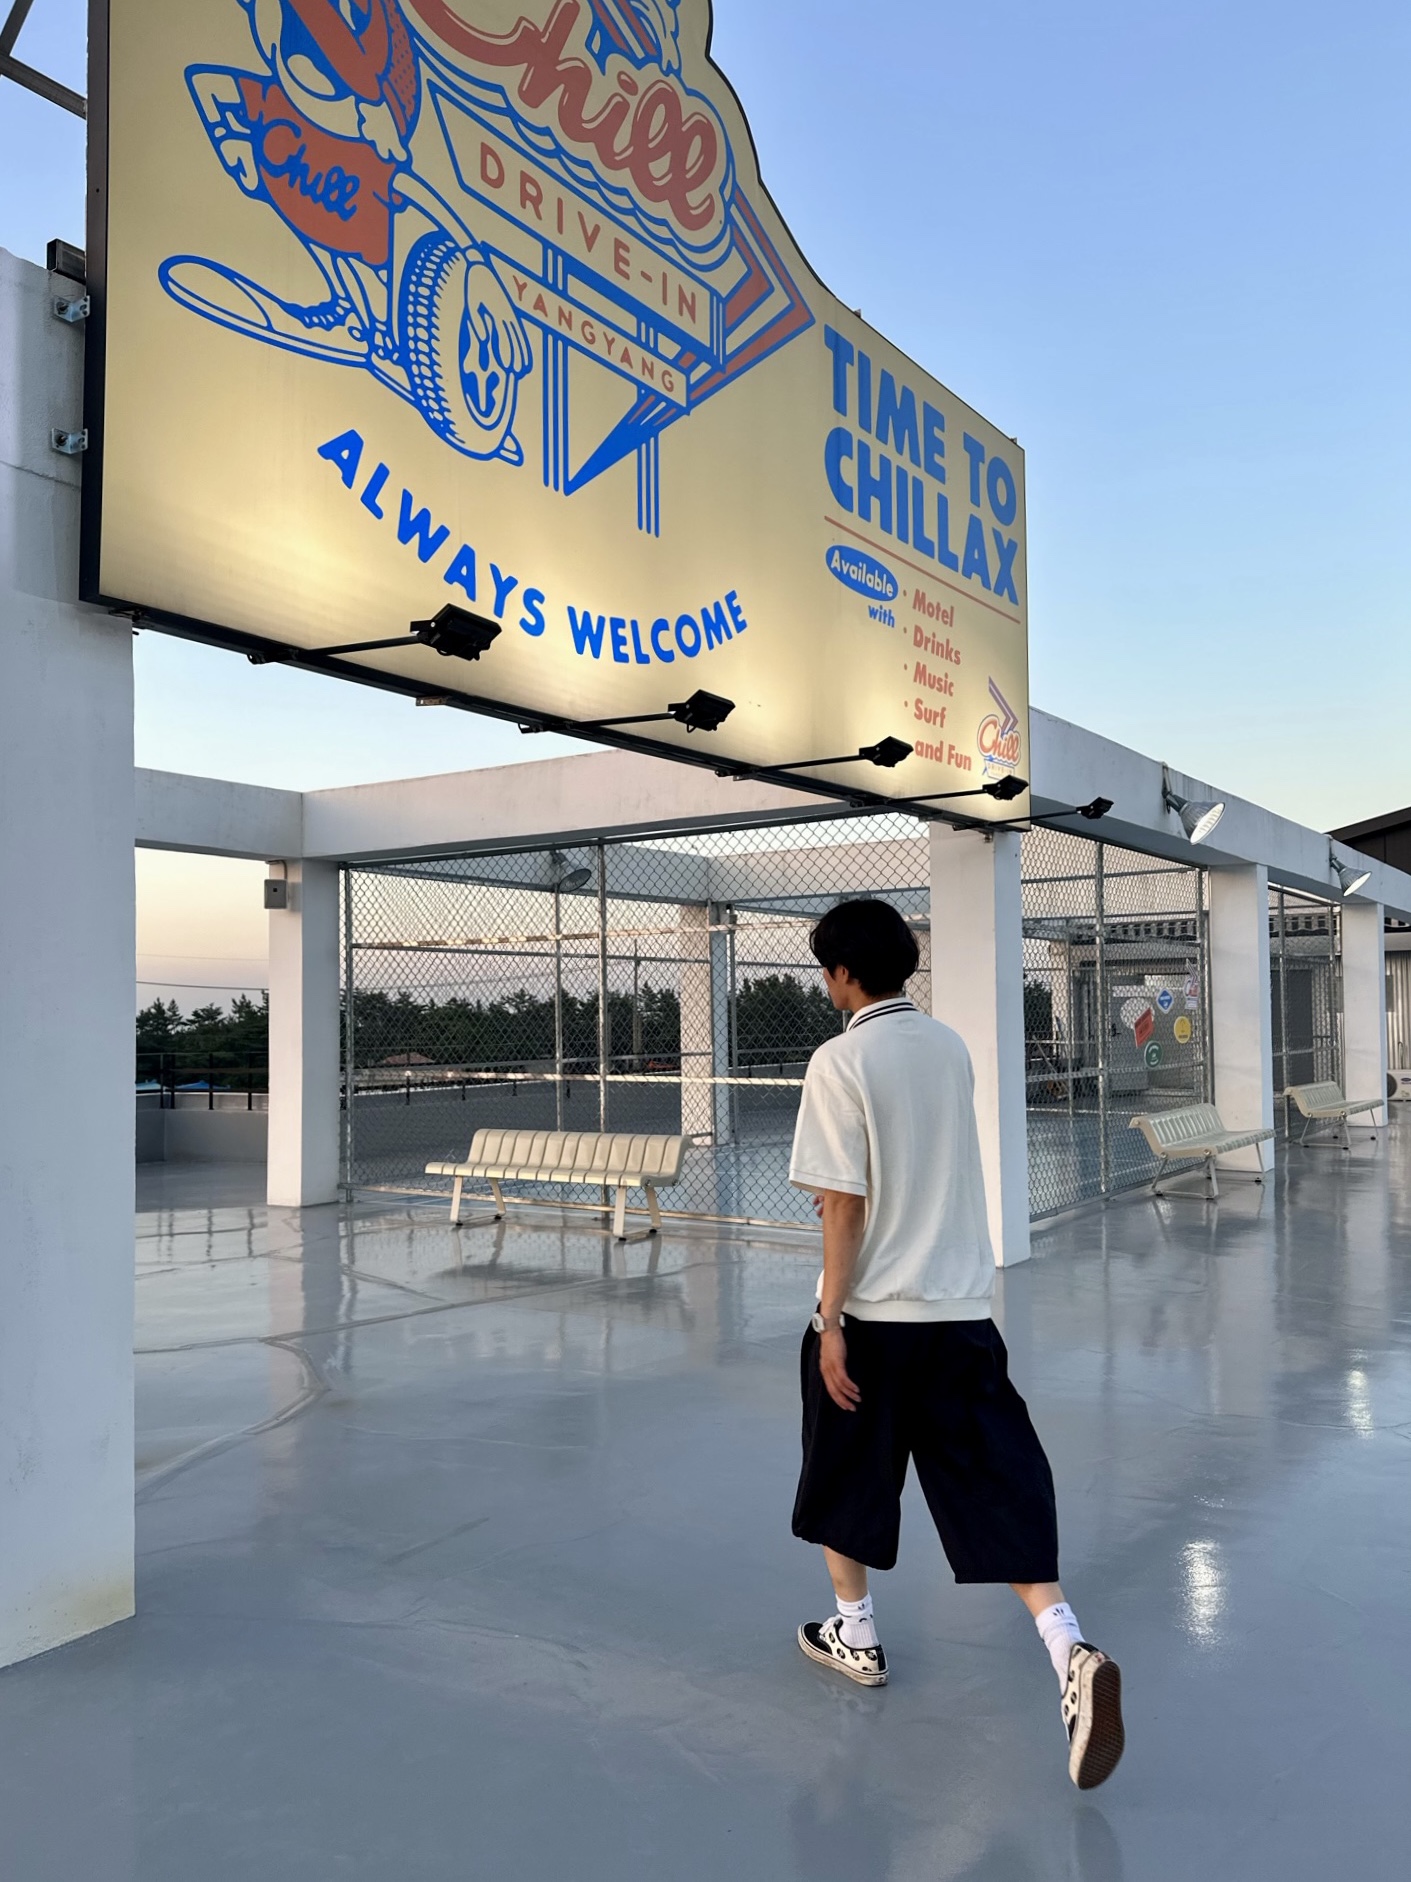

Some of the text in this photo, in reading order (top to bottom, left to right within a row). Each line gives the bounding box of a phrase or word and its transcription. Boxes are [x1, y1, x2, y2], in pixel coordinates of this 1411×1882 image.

[257, 118, 361, 222] Chill
[480, 142, 697, 324] DRIVE-IN
[511, 275, 675, 394] YANGYANG
[824, 323, 1017, 527] TIME TO
[824, 426, 1019, 607] CHILLAX
[316, 428, 748, 665] ALWAYS WELCOME
[831, 550, 894, 597] Available
[868, 604, 895, 628] with
[912, 589, 954, 627] Motel
[913, 625, 961, 665] Drinks
[913, 662, 954, 697] Music
[913, 698, 946, 728] Surf
[914, 740, 944, 764] and
[947, 743, 972, 772] Fun
[979, 717, 1020, 763] Chill
